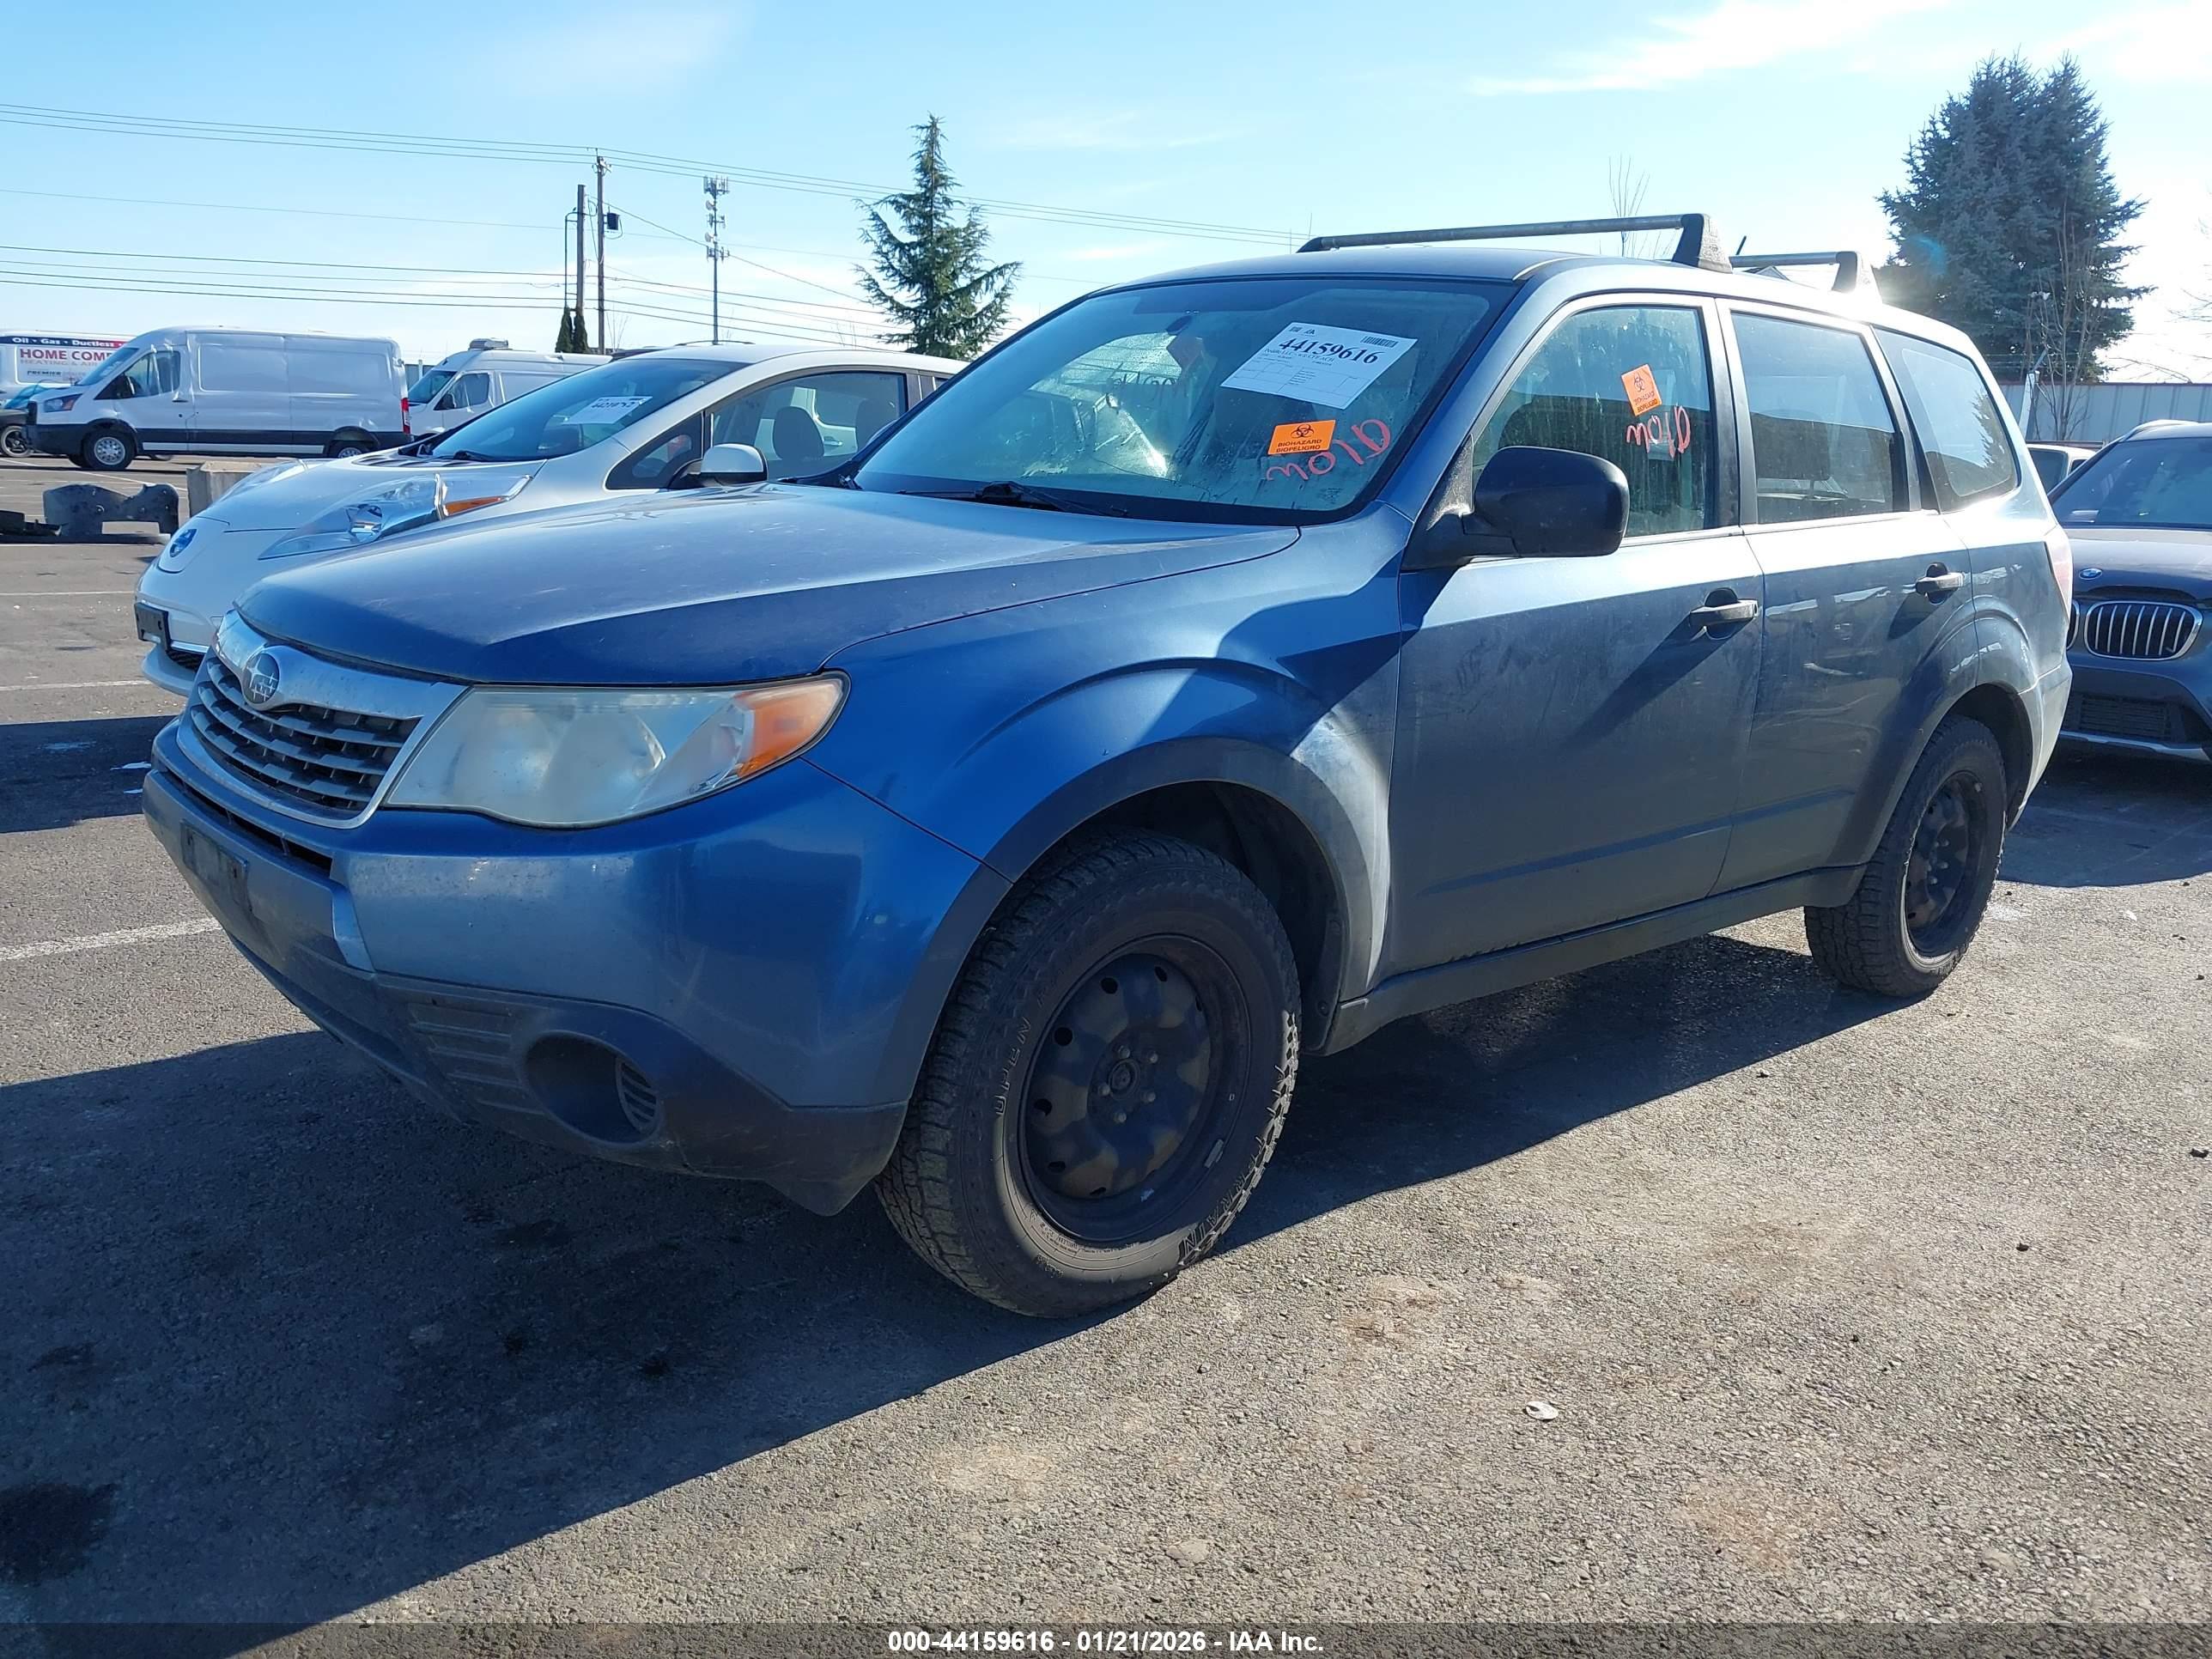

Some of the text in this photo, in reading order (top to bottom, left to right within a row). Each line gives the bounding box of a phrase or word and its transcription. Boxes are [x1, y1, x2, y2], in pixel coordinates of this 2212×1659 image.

[20, 349, 67, 360] HOME
[1279, 337, 1386, 364] 44159616
[1277, 439, 1322, 447] BIOHAZARD
[1276, 444, 1321, 453] BIOPELIGRO
